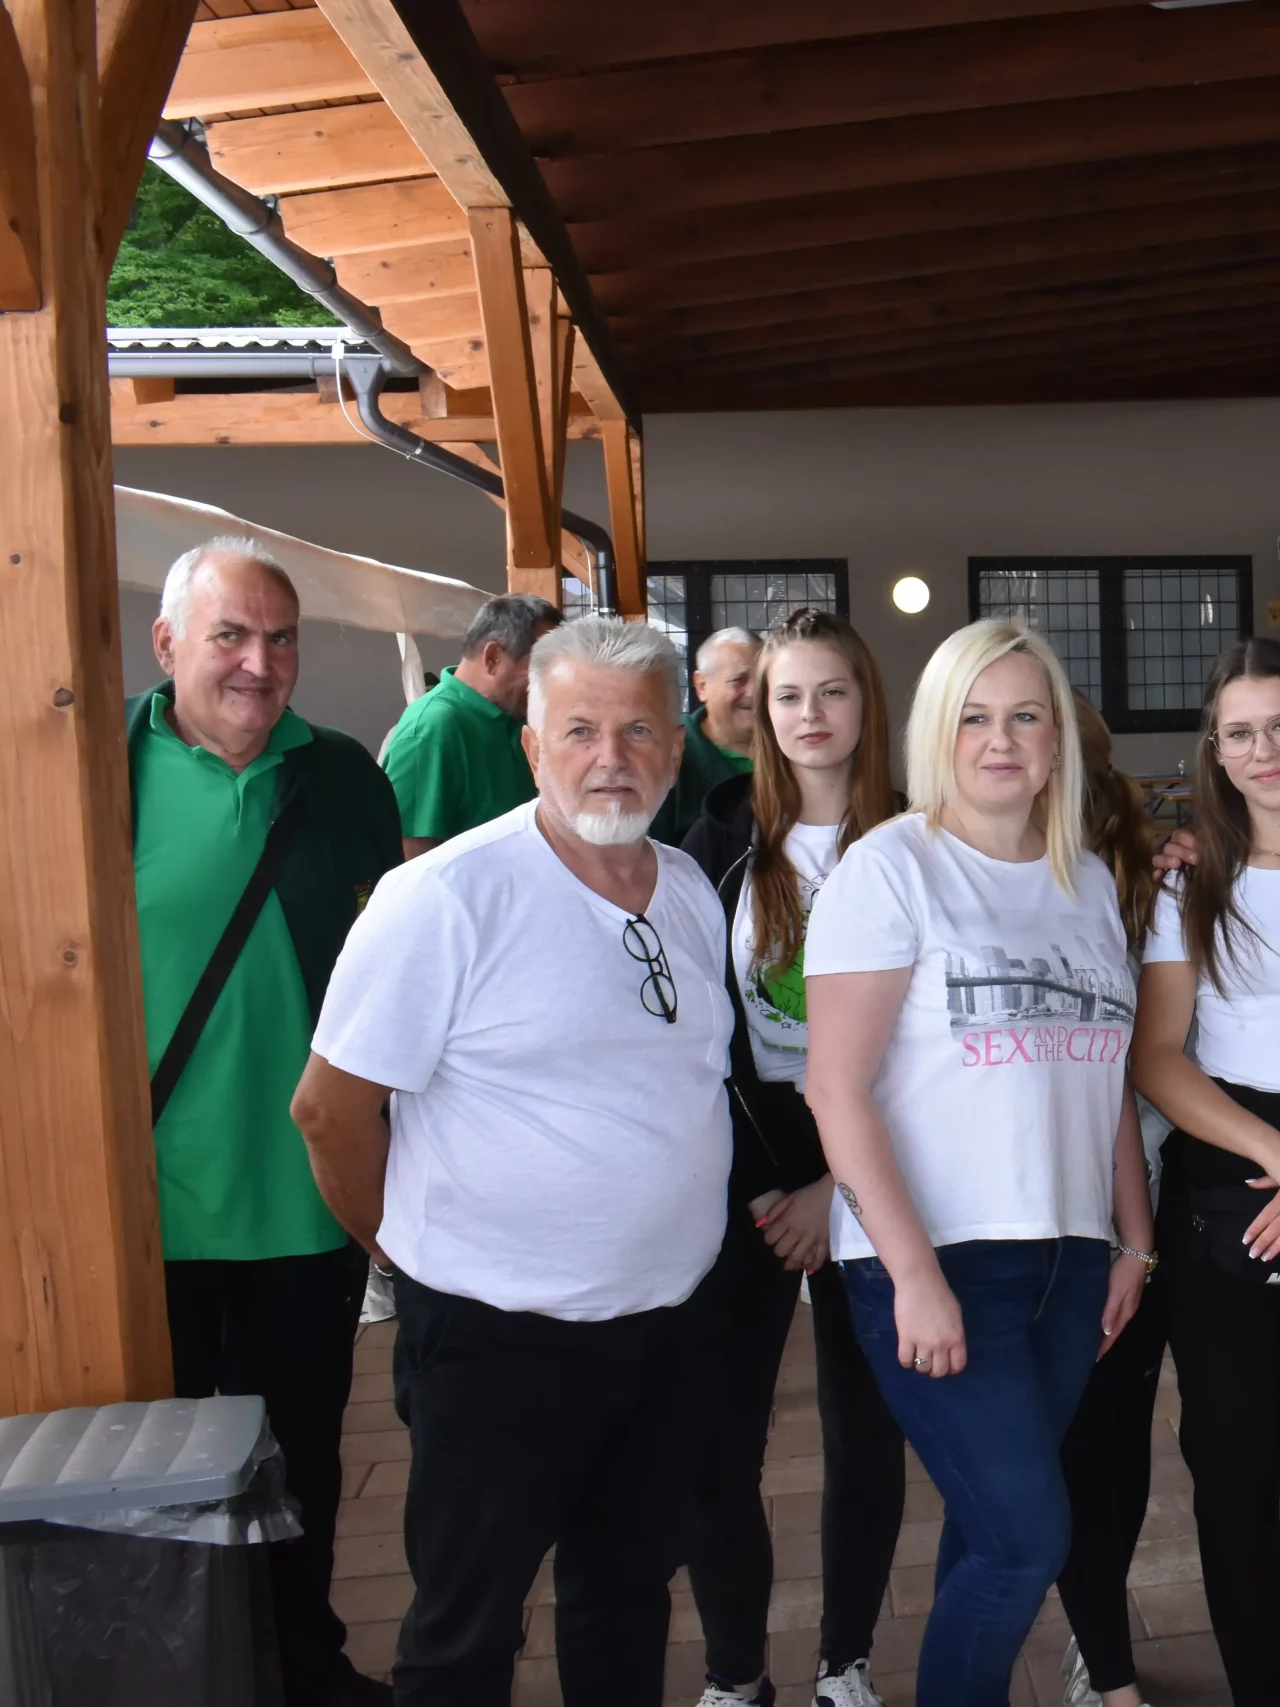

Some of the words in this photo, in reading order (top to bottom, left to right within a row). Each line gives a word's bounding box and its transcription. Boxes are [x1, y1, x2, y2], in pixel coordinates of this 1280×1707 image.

[963, 1027, 1034, 1067] SEX
[1033, 1026, 1067, 1043] AND
[1066, 1027, 1128, 1064] CITY
[1034, 1043, 1063, 1061] THE
